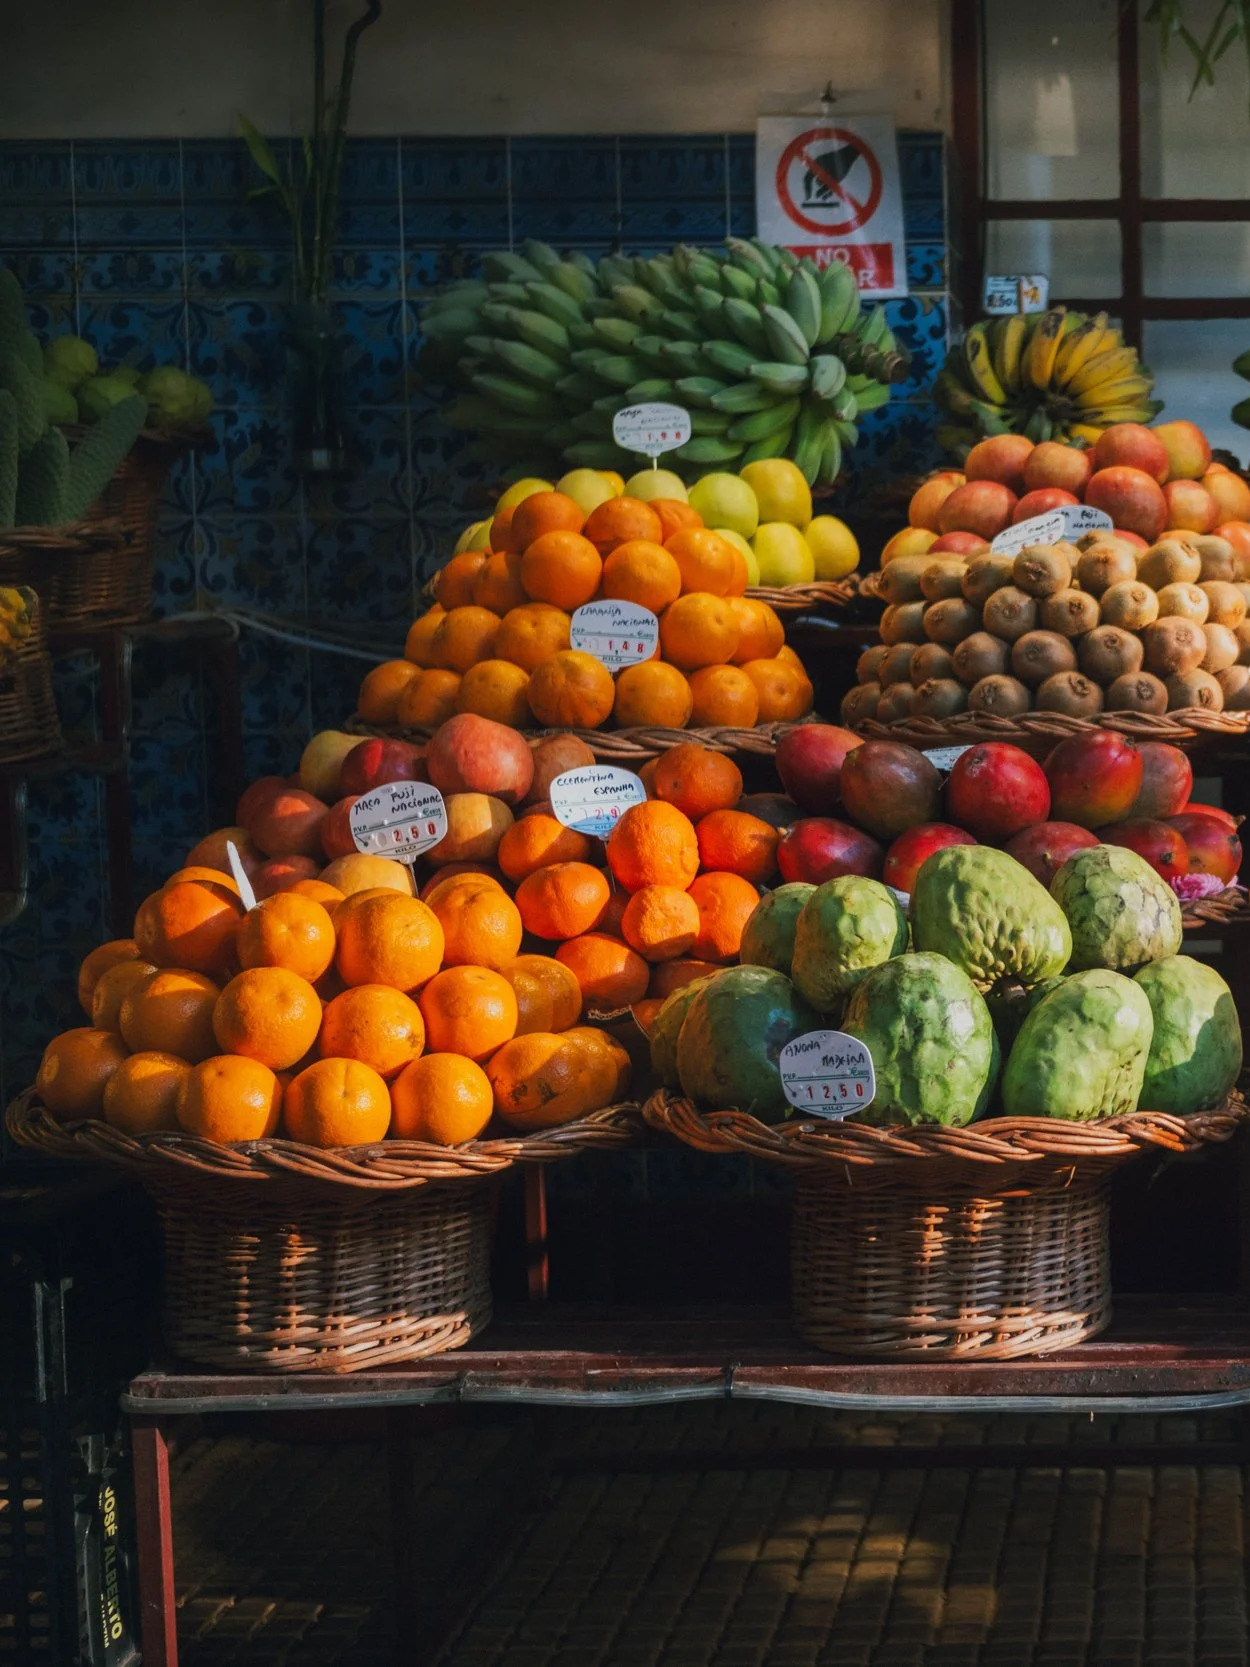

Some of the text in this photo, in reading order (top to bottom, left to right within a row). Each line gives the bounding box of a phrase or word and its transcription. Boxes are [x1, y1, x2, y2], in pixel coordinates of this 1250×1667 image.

[816, 248, 849, 270] NO
[594, 783, 634, 796] ESPANHA
[354, 798, 381, 815] MAÇA
[393, 823, 437, 843] 2,50
[785, 1040, 820, 1057] ANONA
[807, 1083, 863, 1103] 12,50
[104, 1487, 118, 1540] JOSÉ
[104, 1545, 122, 1639] ALBERTO
